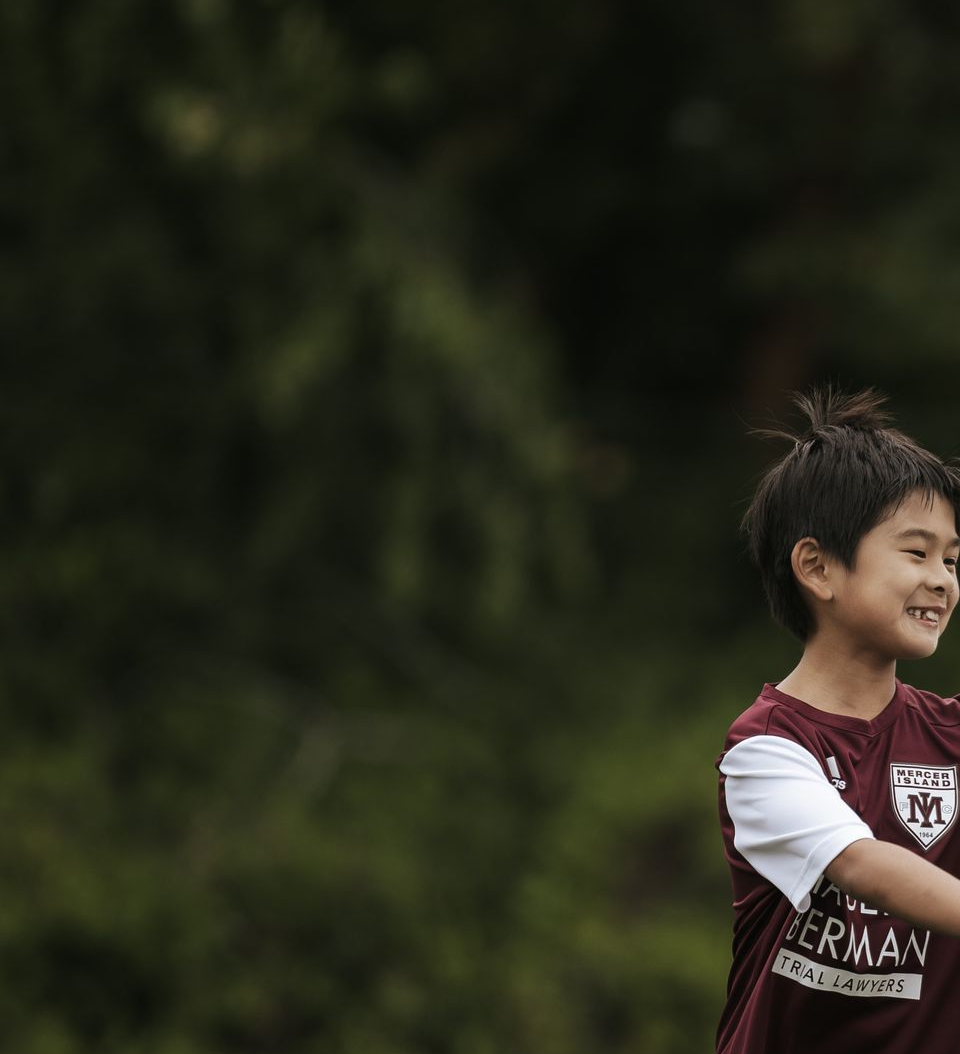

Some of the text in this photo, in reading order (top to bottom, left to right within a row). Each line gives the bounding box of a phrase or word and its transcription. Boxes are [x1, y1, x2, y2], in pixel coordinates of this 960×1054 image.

[896, 769, 949, 780] MERCER
[897, 777, 951, 787] ISLAND
[785, 908, 931, 967] BERMAN
[780, 956, 905, 993] TRIAL LAWYERS
